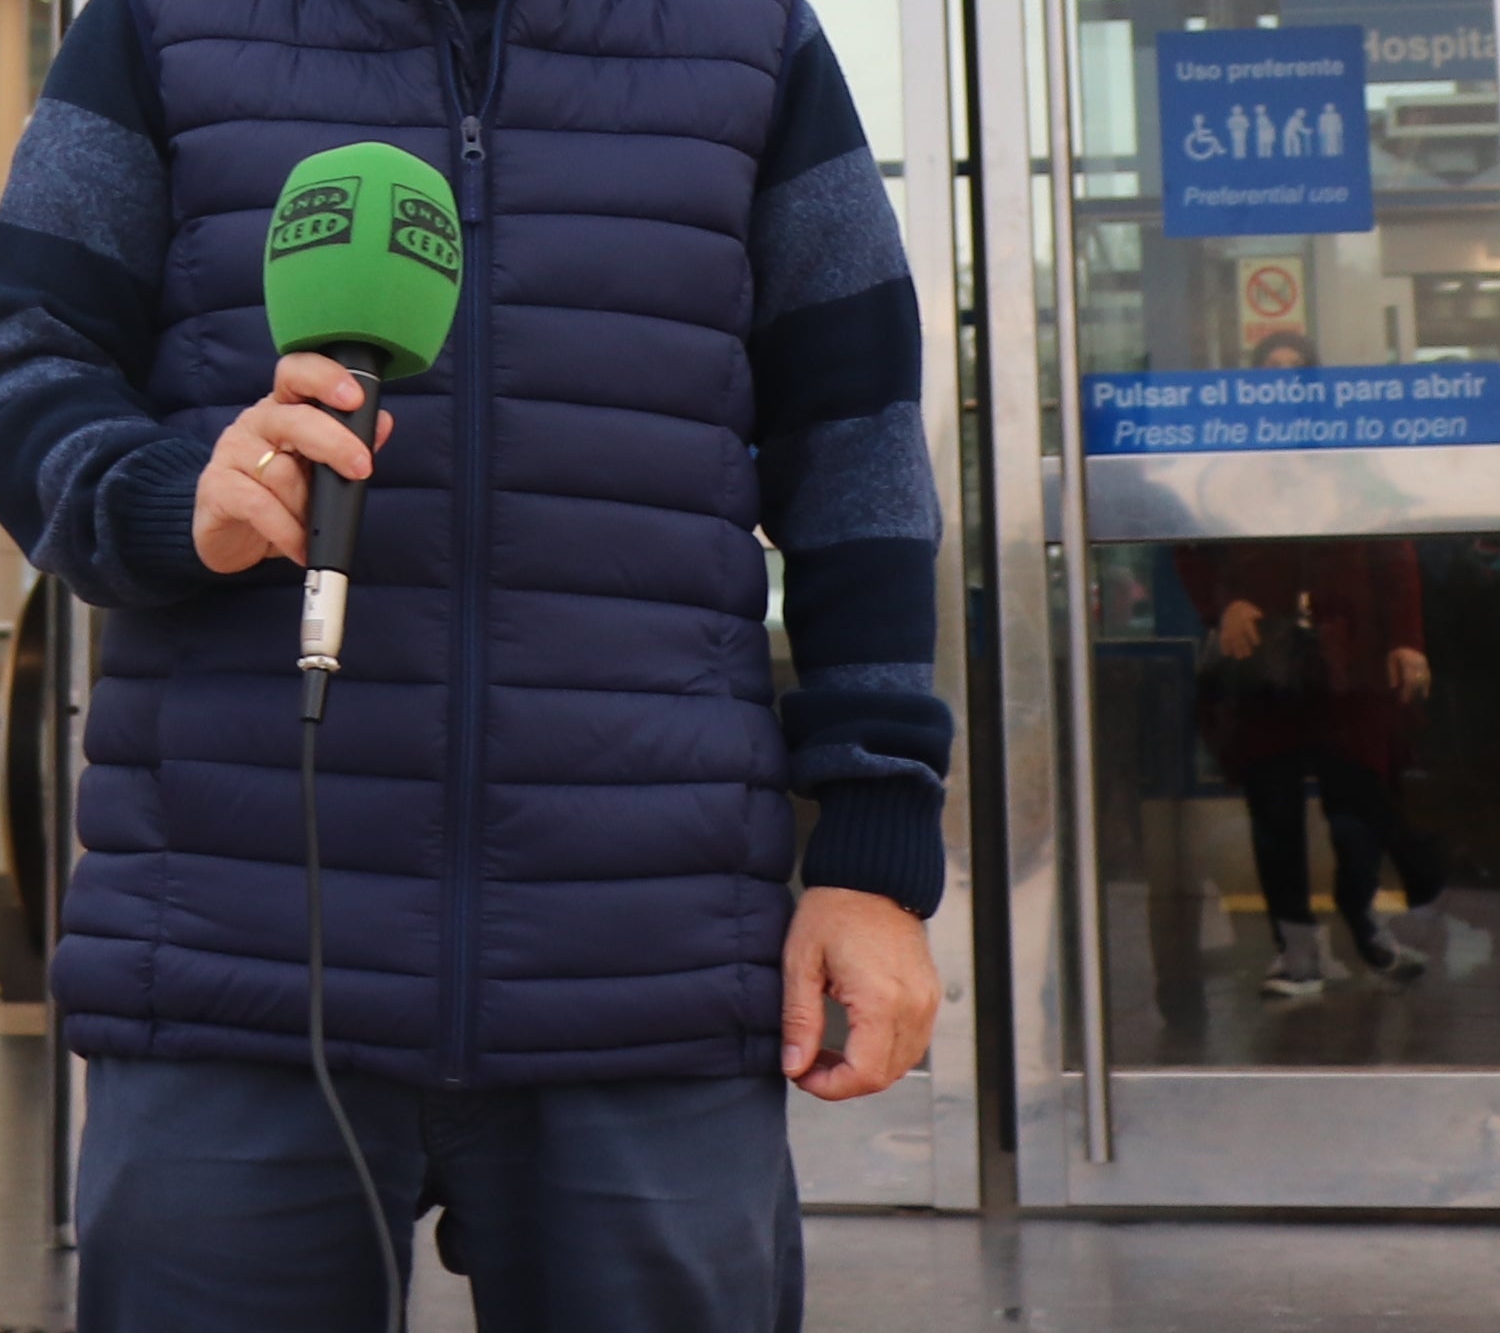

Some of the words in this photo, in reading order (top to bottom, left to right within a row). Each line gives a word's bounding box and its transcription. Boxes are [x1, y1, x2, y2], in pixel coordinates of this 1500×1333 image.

[1175, 60, 1220, 81] Uso
[1228, 57, 1345, 84] preferente
[282, 192, 341, 217] ONDA
[1183, 184, 1304, 207] Preferential
[1309, 185, 1349, 204] use
[281, 217, 337, 243] CERO
[407, 229, 454, 265] CERO
[1093, 381, 1191, 410] Pulsar
[1199, 379, 1227, 407] el
[1236, 374, 1326, 406] botón
[1334, 379, 1403, 408] para
[1412, 373, 1487, 401] abrir
[1114, 420, 1195, 448] Press
[1203, 419, 1248, 445] the
[1257, 416, 1349, 443] button
[1355, 415, 1384, 441] to
[1392, 413, 1468, 446] open
